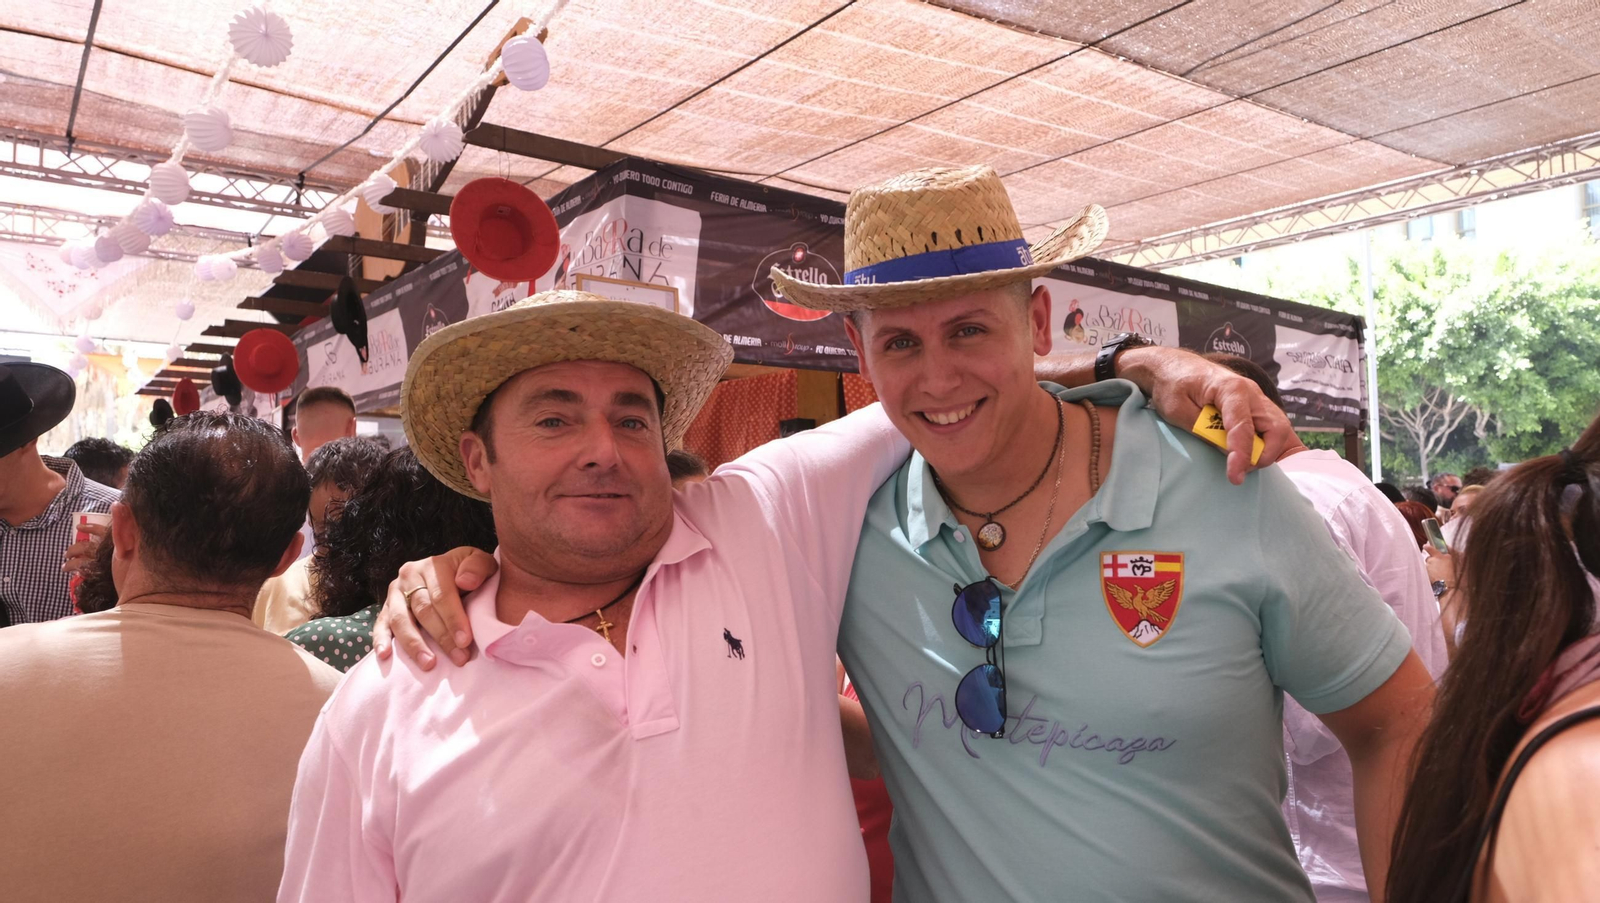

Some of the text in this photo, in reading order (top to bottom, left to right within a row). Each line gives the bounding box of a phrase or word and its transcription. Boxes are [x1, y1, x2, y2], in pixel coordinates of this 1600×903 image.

[642, 174, 661, 187] TODO
[662, 179, 694, 195] CONTIGO
[710, 191, 730, 205] FERIA
[730, 196, 740, 208] DE
[740, 199, 768, 213] ALMERIA
[648, 237, 673, 259] de
[733, 335, 762, 347] ALMERIA
[1213, 337, 1247, 355] Estrella
[901, 680, 1177, 767] Mtepicaza
